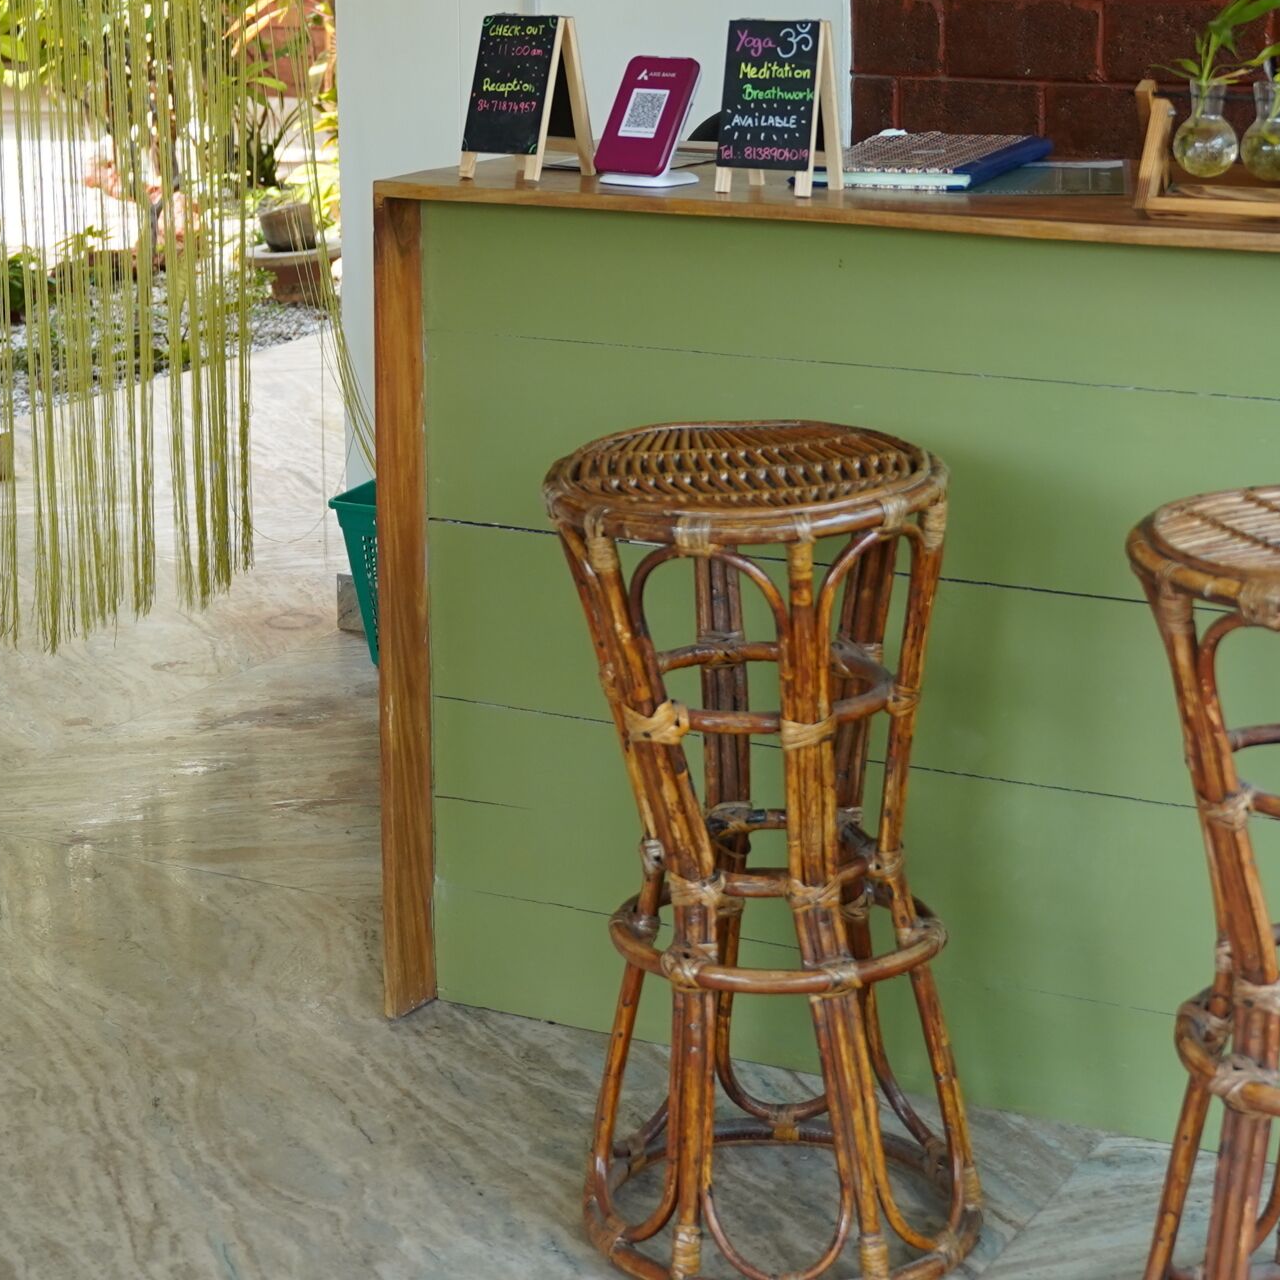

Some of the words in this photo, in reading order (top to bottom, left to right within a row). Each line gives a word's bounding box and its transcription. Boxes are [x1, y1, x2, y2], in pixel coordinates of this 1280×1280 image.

[736, 29, 776, 57] Yoga
[739, 61, 811, 79] Meditation
[483, 77, 535, 97] Reception
[742, 83, 814, 100] Breathwork
[744, 146, 809, 161] 8138904019
